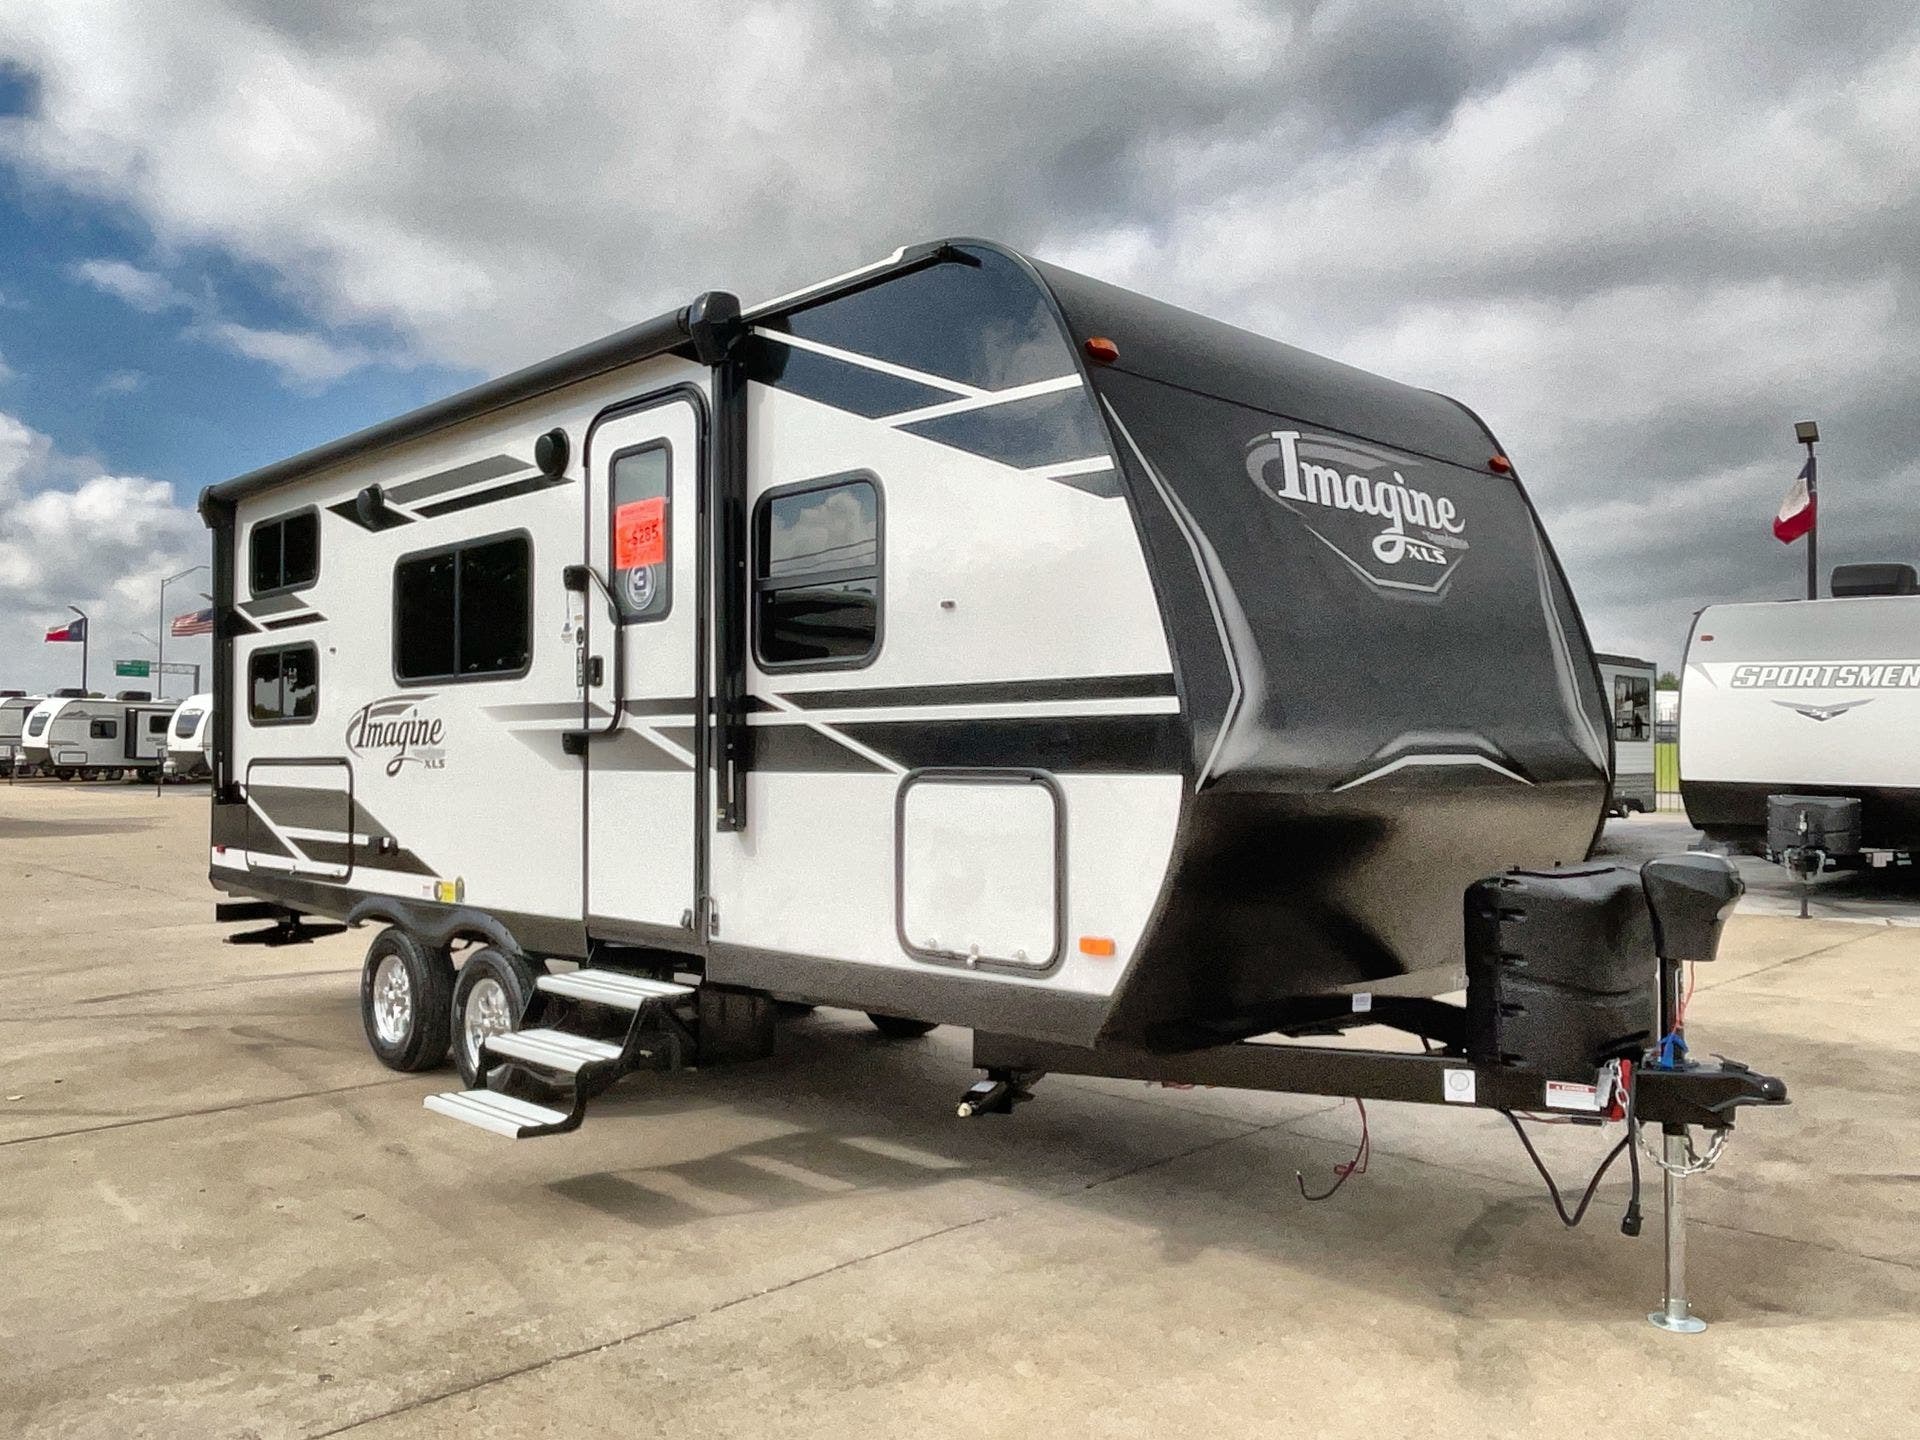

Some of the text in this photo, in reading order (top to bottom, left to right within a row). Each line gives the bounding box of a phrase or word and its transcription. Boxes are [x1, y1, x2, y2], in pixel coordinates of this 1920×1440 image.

[1271, 430, 1466, 564] Imagine
[1406, 544, 1448, 565] XLS
[634, 567, 647, 591] 3
[1732, 665, 1920, 688] SPORTSMEN
[355, 702, 446, 777] Imagine
[424, 759, 446, 770] XLS
